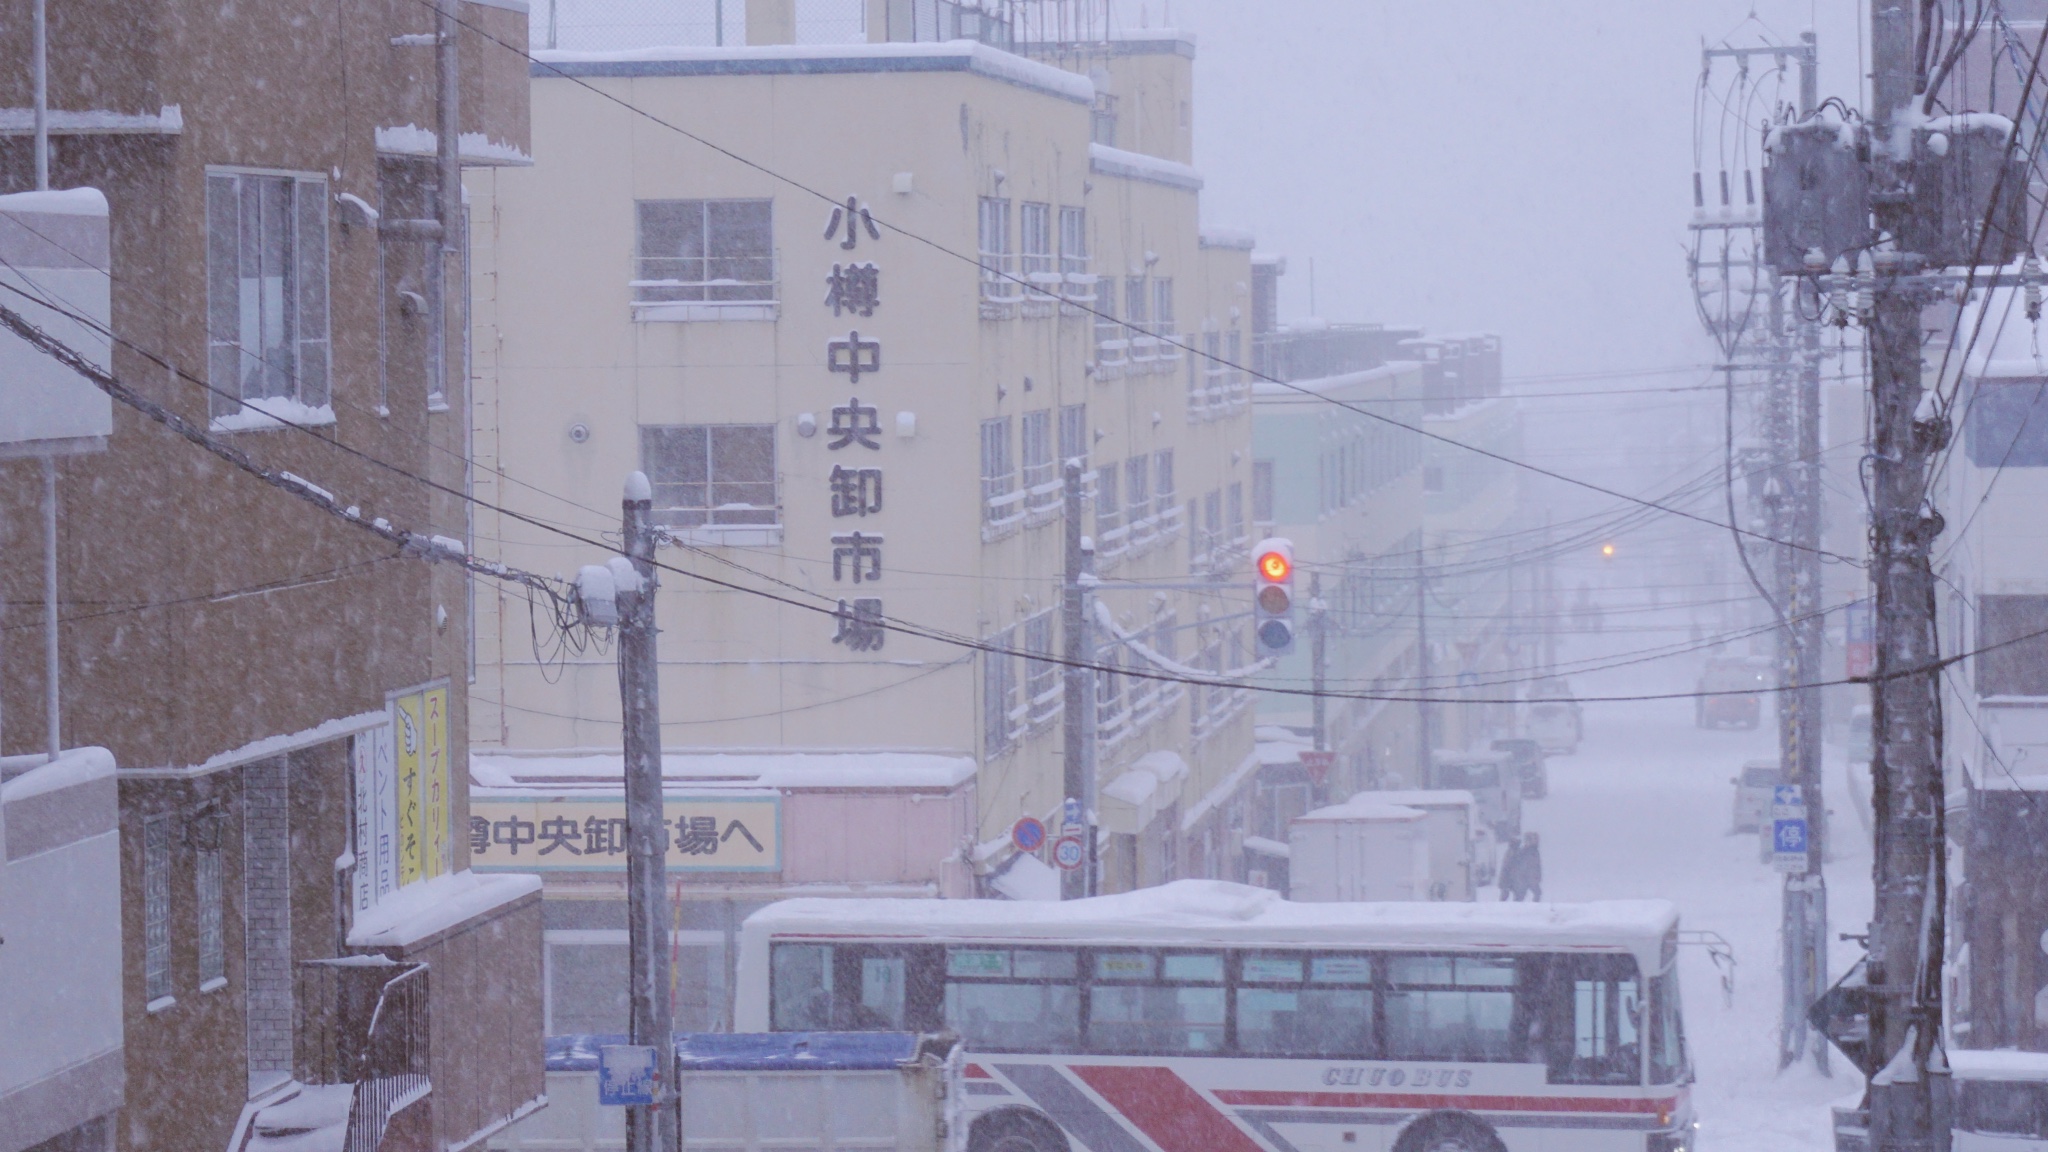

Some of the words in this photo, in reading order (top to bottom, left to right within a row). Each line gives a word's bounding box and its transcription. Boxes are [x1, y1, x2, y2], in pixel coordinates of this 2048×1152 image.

[824, 196, 885, 652] 小樽中央卸市場
[1060, 845, 1080, 861] 30
[1322, 1067, 1406, 1087] CHUO
[1410, 1068, 1473, 1088] BUS
